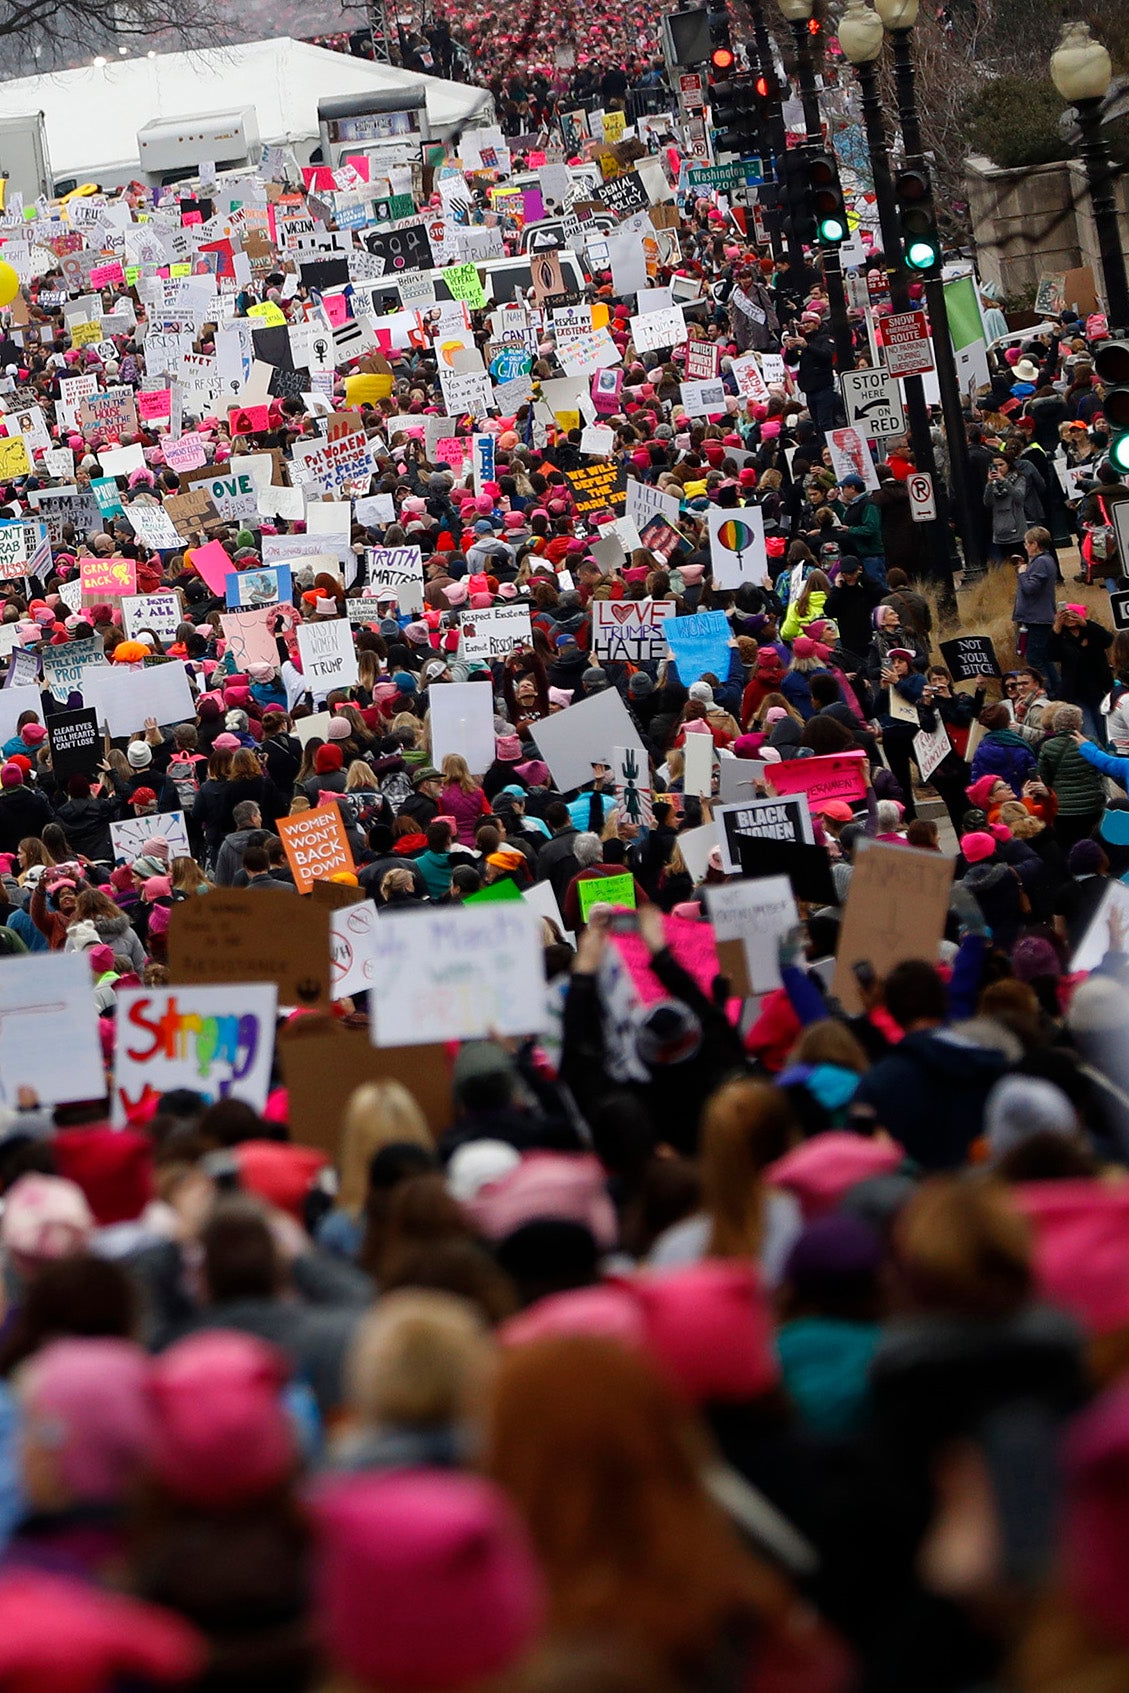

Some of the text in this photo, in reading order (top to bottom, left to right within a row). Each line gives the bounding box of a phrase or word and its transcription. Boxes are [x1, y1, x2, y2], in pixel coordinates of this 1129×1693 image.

[693, 166, 745, 182] Washington
[598, 177, 634, 199] DENIAL
[612, 190, 627, 200] NOT
[610, 193, 642, 211] POLICY
[463, 242, 503, 261] TRUMP
[398, 275, 424, 286] Believe
[450, 275, 474, 285] REPEAL
[507, 313, 522, 323] NAH
[555, 317, 579, 326] RESPECT
[888, 315, 914, 327] SNOW
[502, 327, 534, 342] CAN'T
[557, 325, 593, 336] EXISTENCE
[641, 320, 681, 336] TRUMPS
[886, 324, 921, 335] EMERGENCY
[144, 335, 180, 351] RESIST
[646, 329, 681, 350] HATE
[890, 331, 920, 343] ROUTE
[338, 342, 377, 360] EQUAL
[690, 342, 712, 352] PROTECT
[899, 340, 926, 351] PARKING
[184, 354, 211, 366] NYET
[689, 352, 712, 363] WOMEN'S
[898, 352, 921, 362] DURING
[498, 361, 526, 378] GIRLS
[892, 360, 929, 372] EMERGENCY
[274, 368, 309, 381] CLIMATE
[853, 373, 889, 390] STOP
[445, 380, 460, 390] Yes
[862, 389, 885, 400] HERE
[100, 400, 111, 409] IN
[95, 408, 120, 419] HOUSE
[878, 408, 890, 417] ON
[84, 419, 101, 430] and
[92, 426, 127, 437] SENATE
[871, 417, 899, 432] RED
[304, 432, 366, 468] Put WOMEN
[326, 450, 365, 469] Charge
[336, 454, 372, 476] PEACE
[335, 467, 370, 487] Chance
[567, 462, 617, 480] WE WILL
[572, 472, 618, 490] DEFEAT
[588, 486, 613, 497] THE
[576, 498, 608, 512] DARK
[0, 552, 18, 565] MY
[372, 549, 419, 567] TRUTH
[83, 562, 109, 574] GRAB
[84, 576, 112, 588] BACK
[133, 606, 174, 618] 4 ALL
[461, 610, 492, 624] Respect
[600, 625, 662, 642] TRUMPS
[595, 638, 670, 660] HATE
[958, 639, 982, 652] NOT
[44, 652, 104, 670] STILL HAVE TO
[958, 651, 989, 665] YOUR
[310, 657, 342, 676] TRUMP
[961, 662, 996, 676] BITCH
[53, 722, 93, 735] CLEAR EYES
[52, 729, 96, 744] FULL HEARTS
[55, 736, 95, 750] CAN'T LOSE
[283, 811, 337, 837] WOMEN
[736, 806, 789, 828] BLACK
[288, 824, 339, 849] WON'T
[294, 836, 340, 866] BACK
[299, 851, 348, 880] DOWN
[125, 996, 260, 1080] Strong
